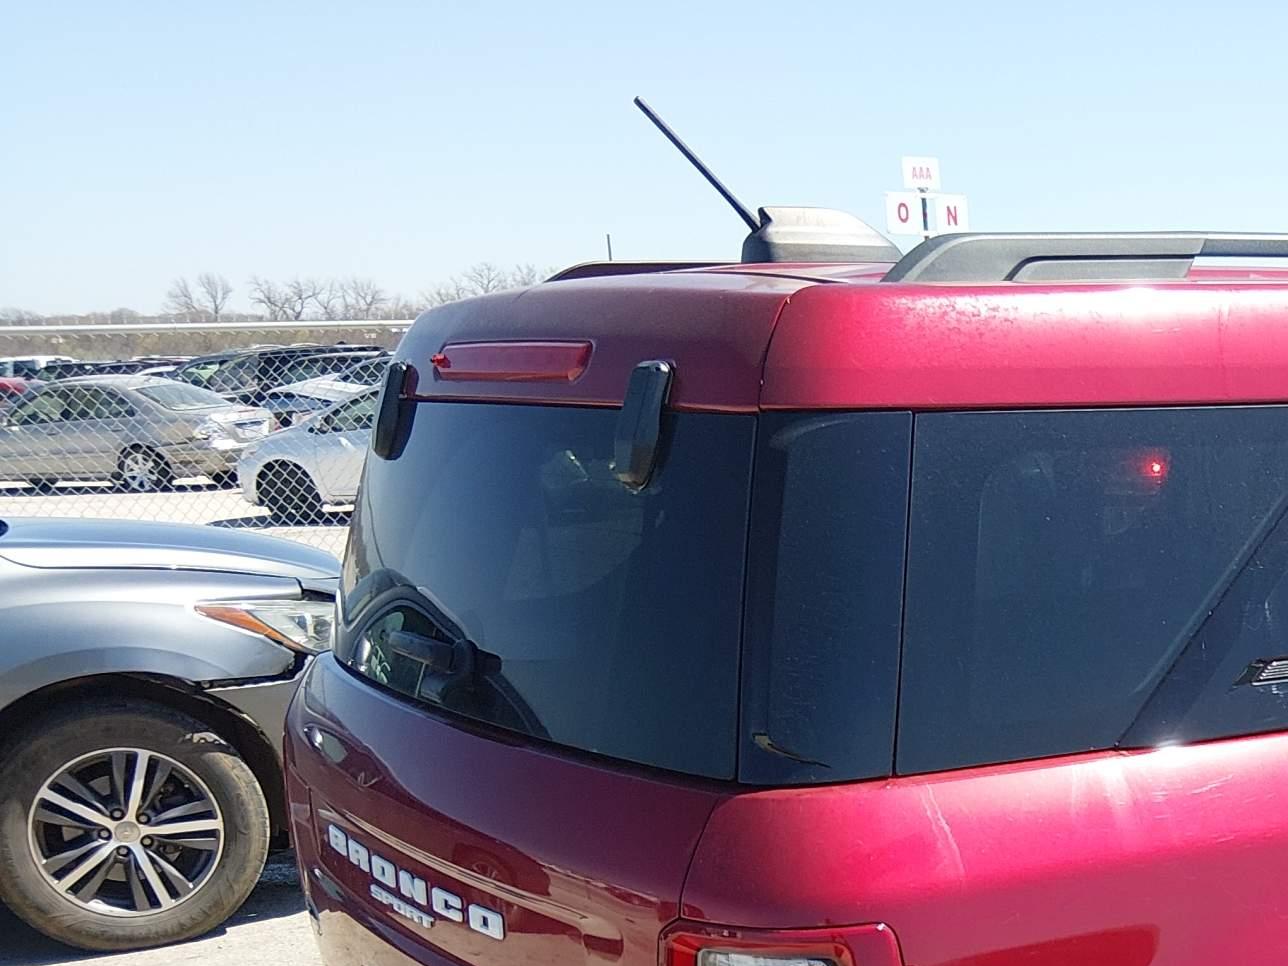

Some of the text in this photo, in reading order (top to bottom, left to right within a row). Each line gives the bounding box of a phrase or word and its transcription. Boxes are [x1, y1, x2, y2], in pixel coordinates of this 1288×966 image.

[912, 166, 932, 180] AAA
[946, 205, 958, 226] N
[328, 824, 506, 940] BRONCO
[370, 884, 435, 929] SPORT
